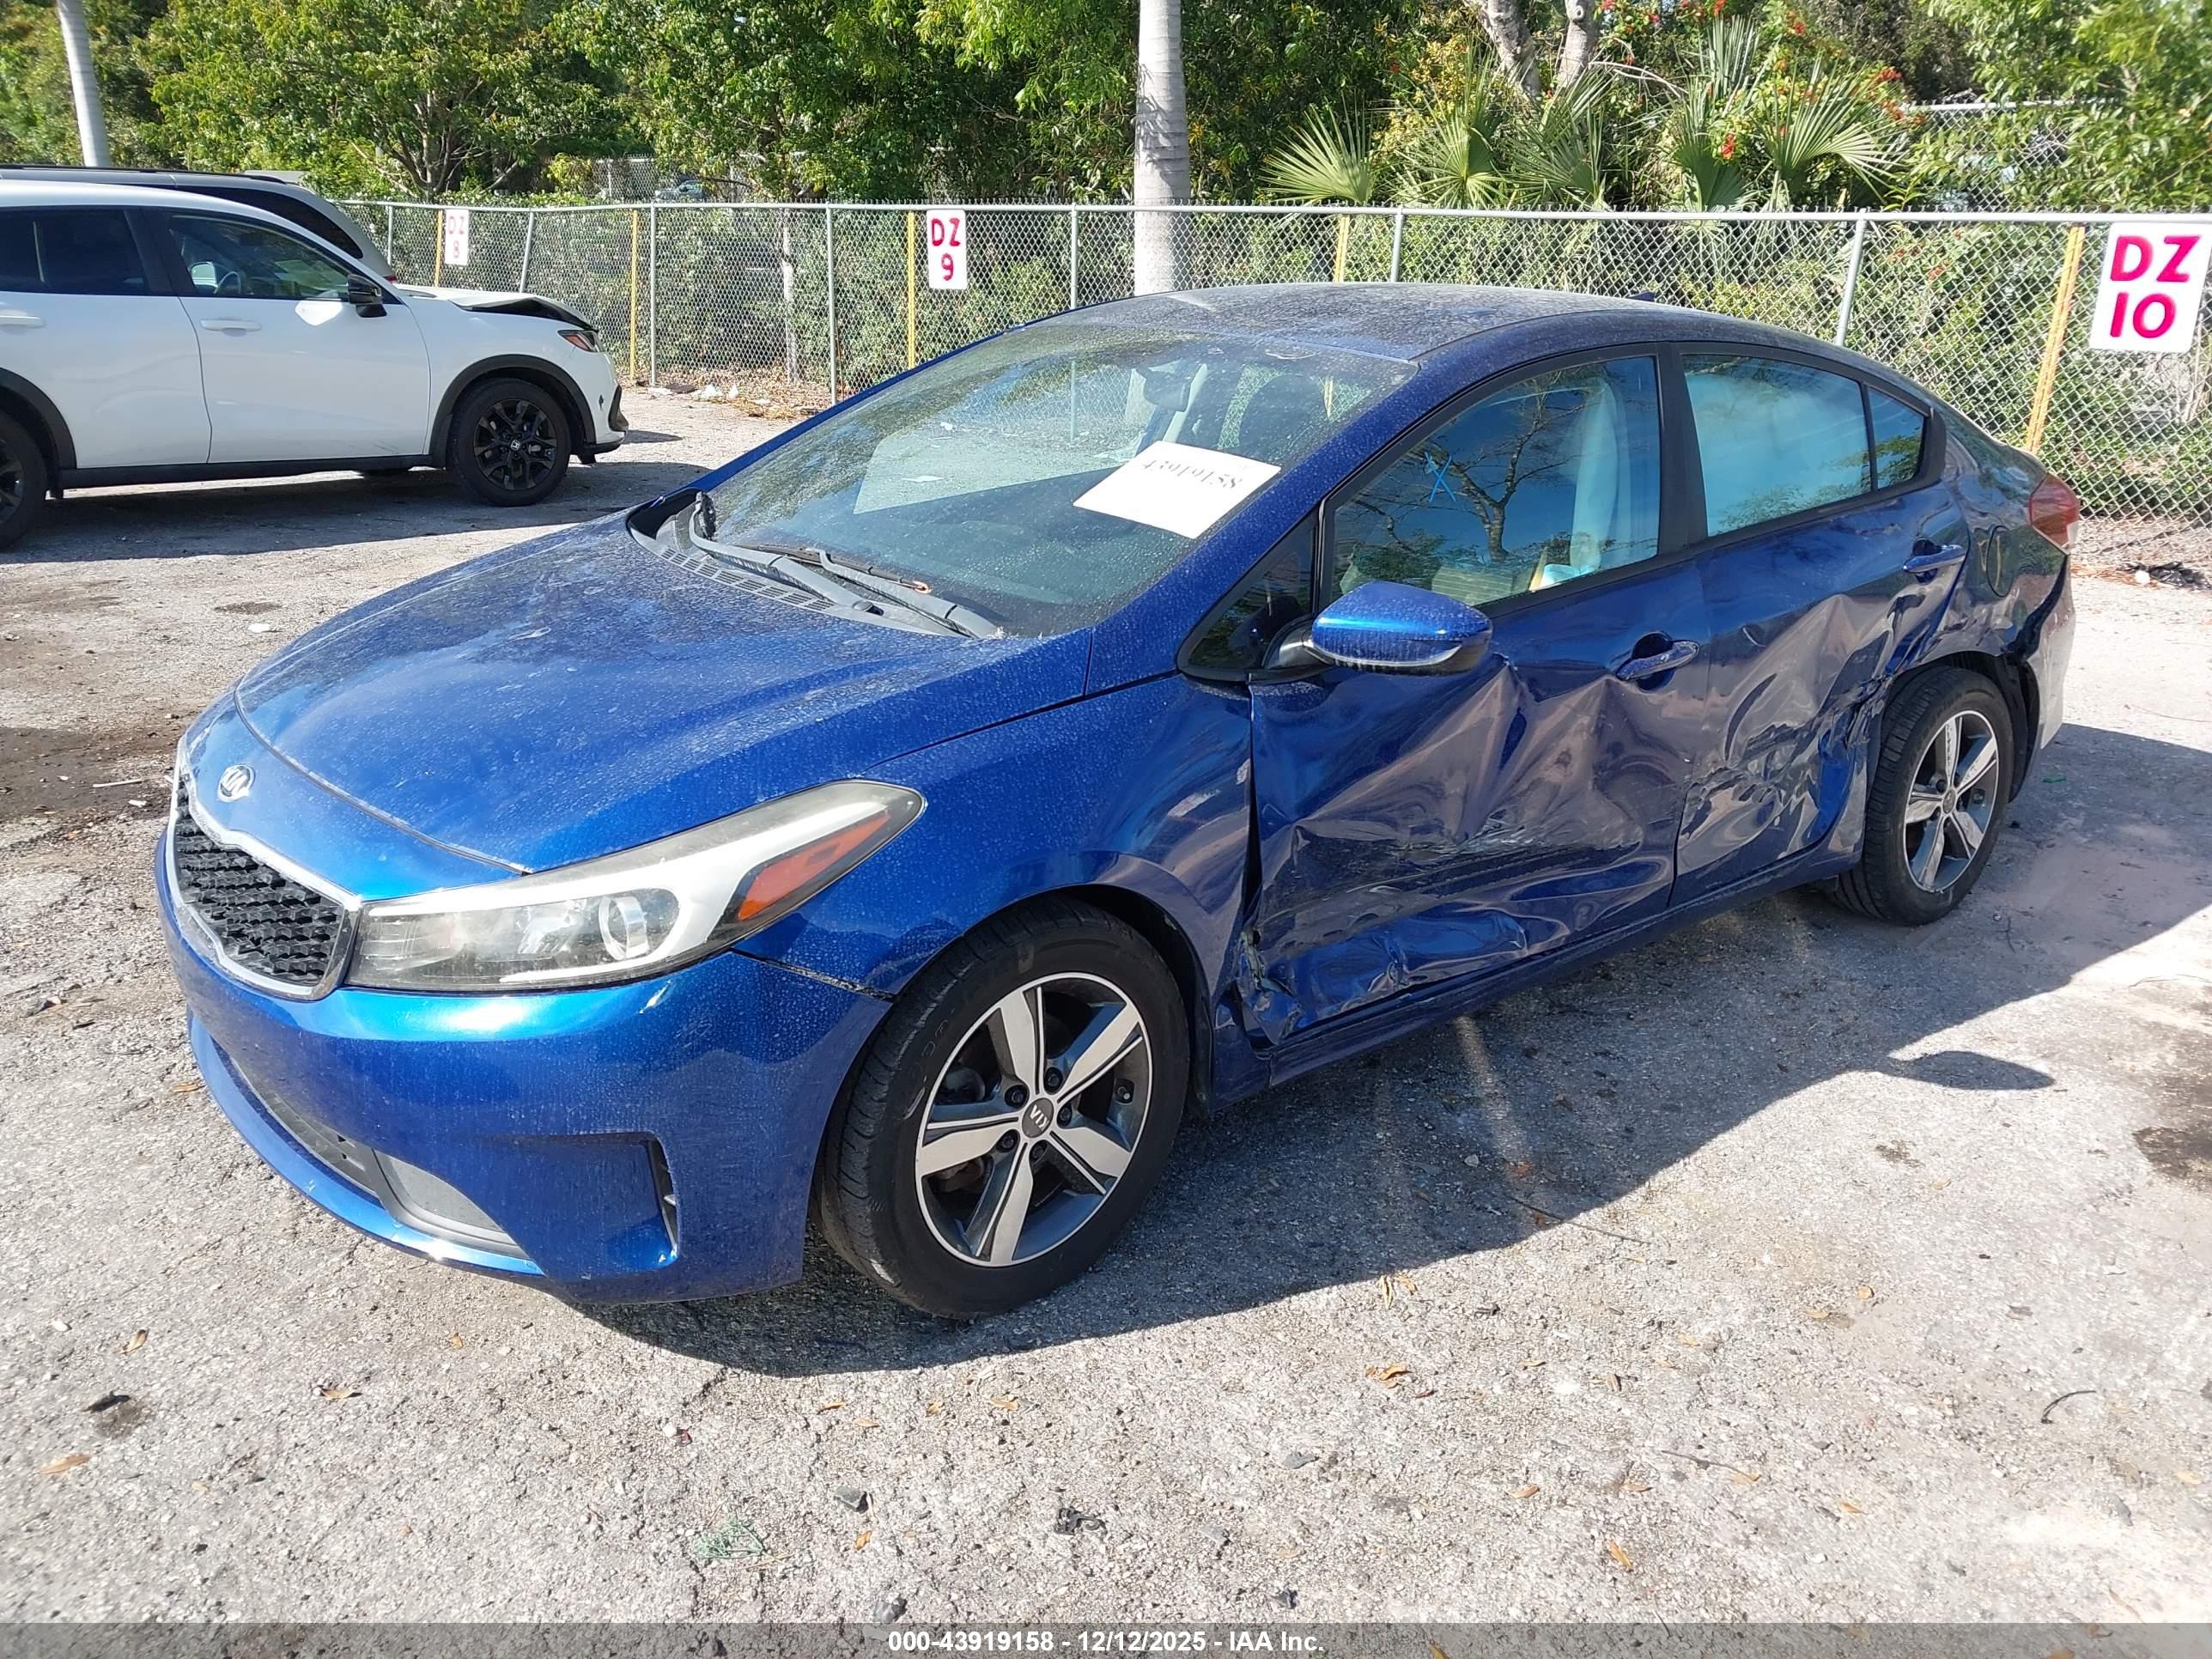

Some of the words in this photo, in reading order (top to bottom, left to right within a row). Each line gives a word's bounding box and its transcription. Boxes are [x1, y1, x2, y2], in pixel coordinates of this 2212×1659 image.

[448, 215, 465, 234] DZ
[931, 217, 961, 247] DZ
[941, 252, 954, 282] 9
[2110, 235, 2202, 283] DZ
[1030, 1103, 1050, 1132] KIA
